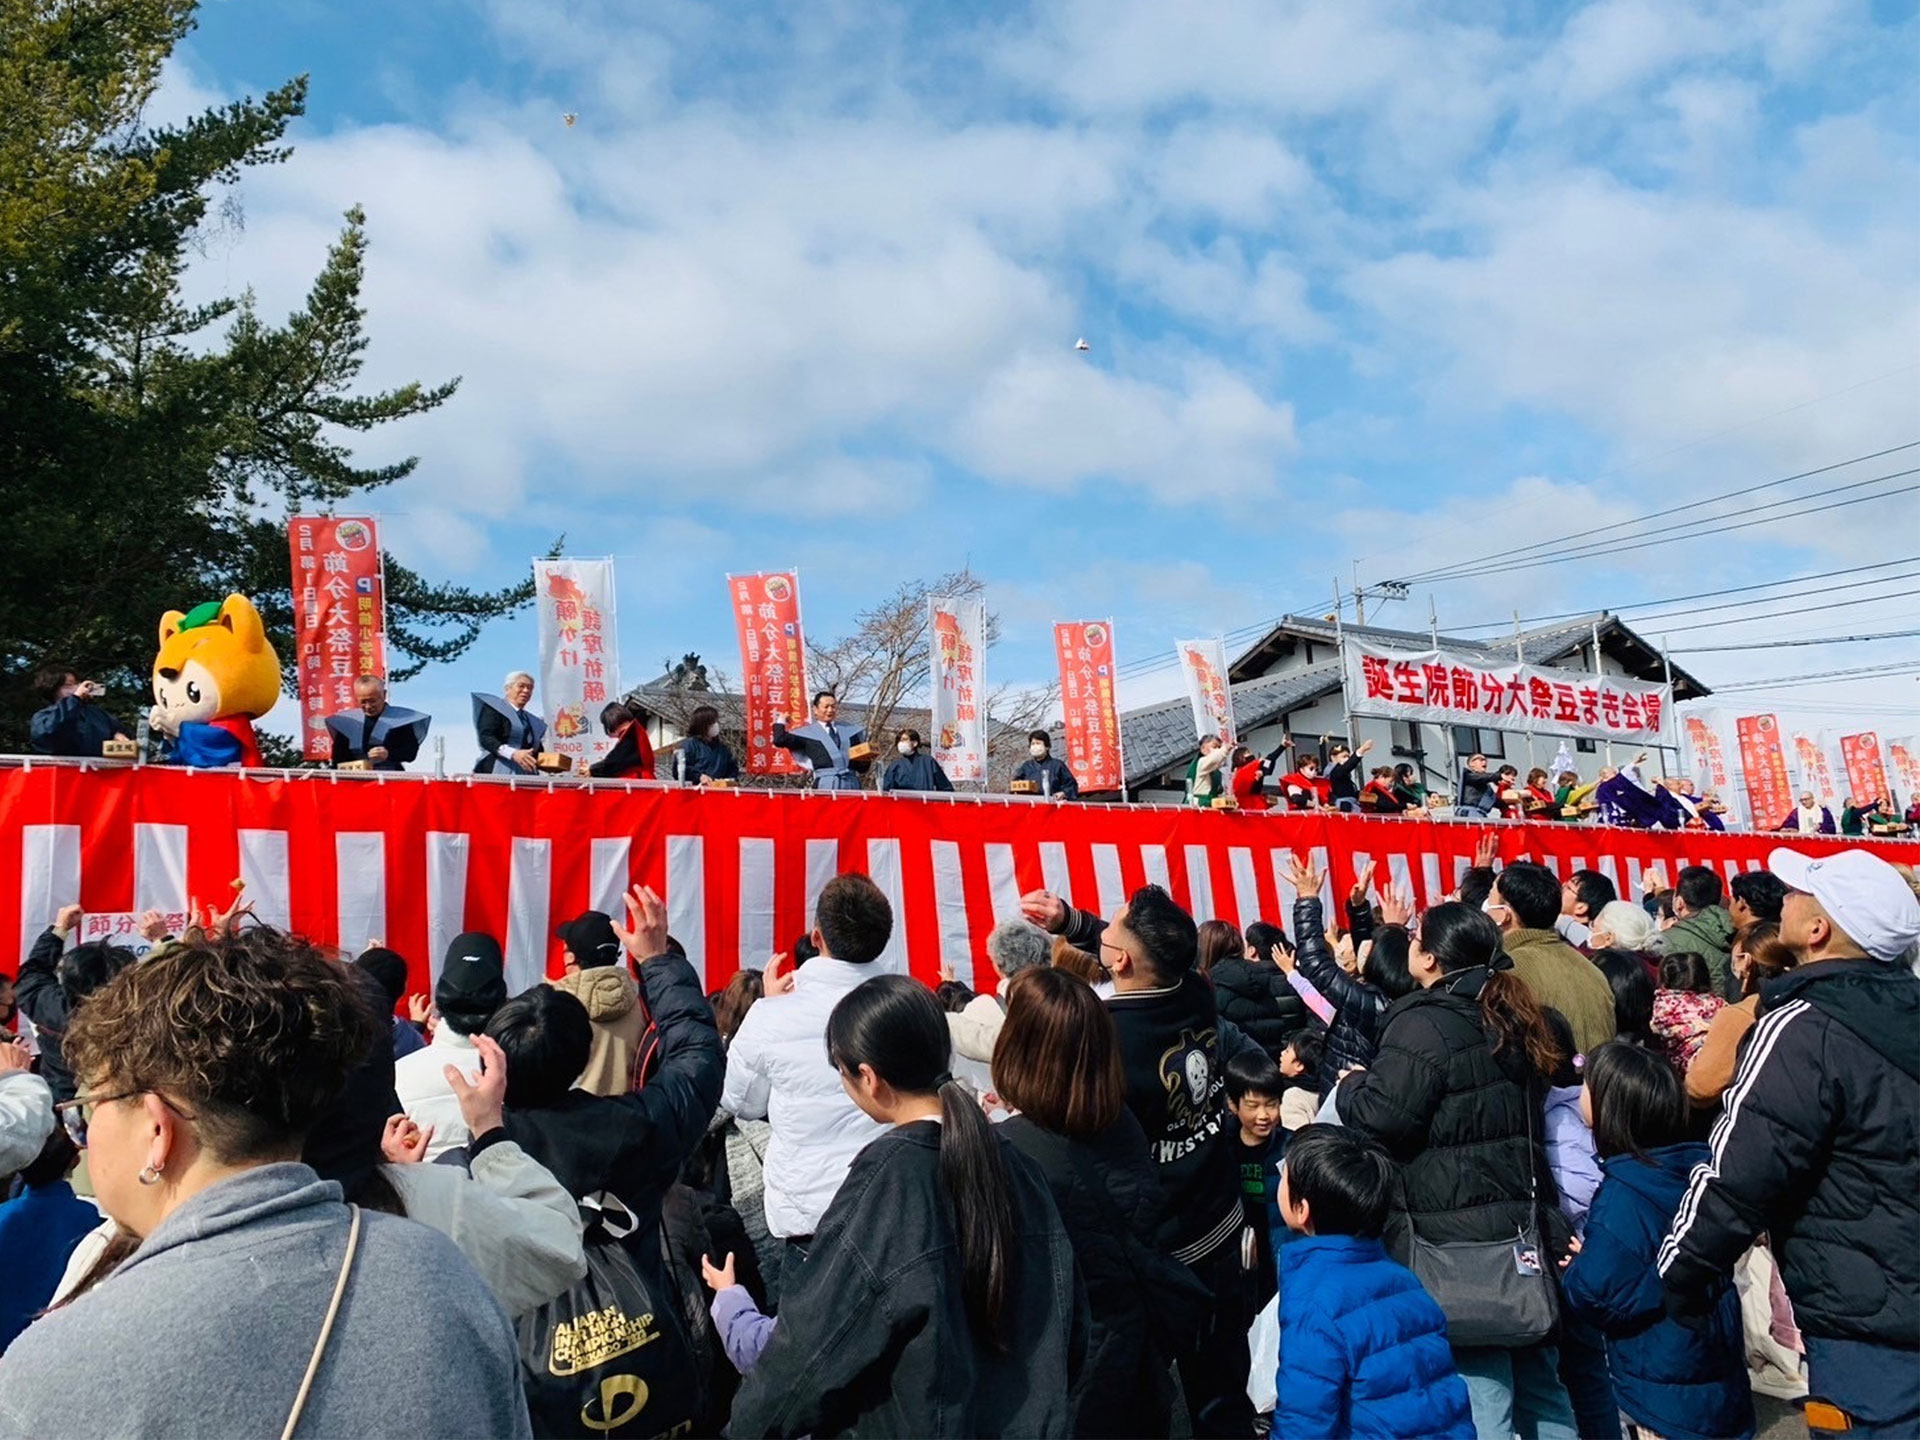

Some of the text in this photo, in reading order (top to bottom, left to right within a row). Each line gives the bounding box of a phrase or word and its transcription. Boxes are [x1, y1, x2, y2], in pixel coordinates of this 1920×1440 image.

[1361, 654, 1662, 732] 誕生院節分大祭豆まき会場
[88, 912, 185, 935] 節分祭
